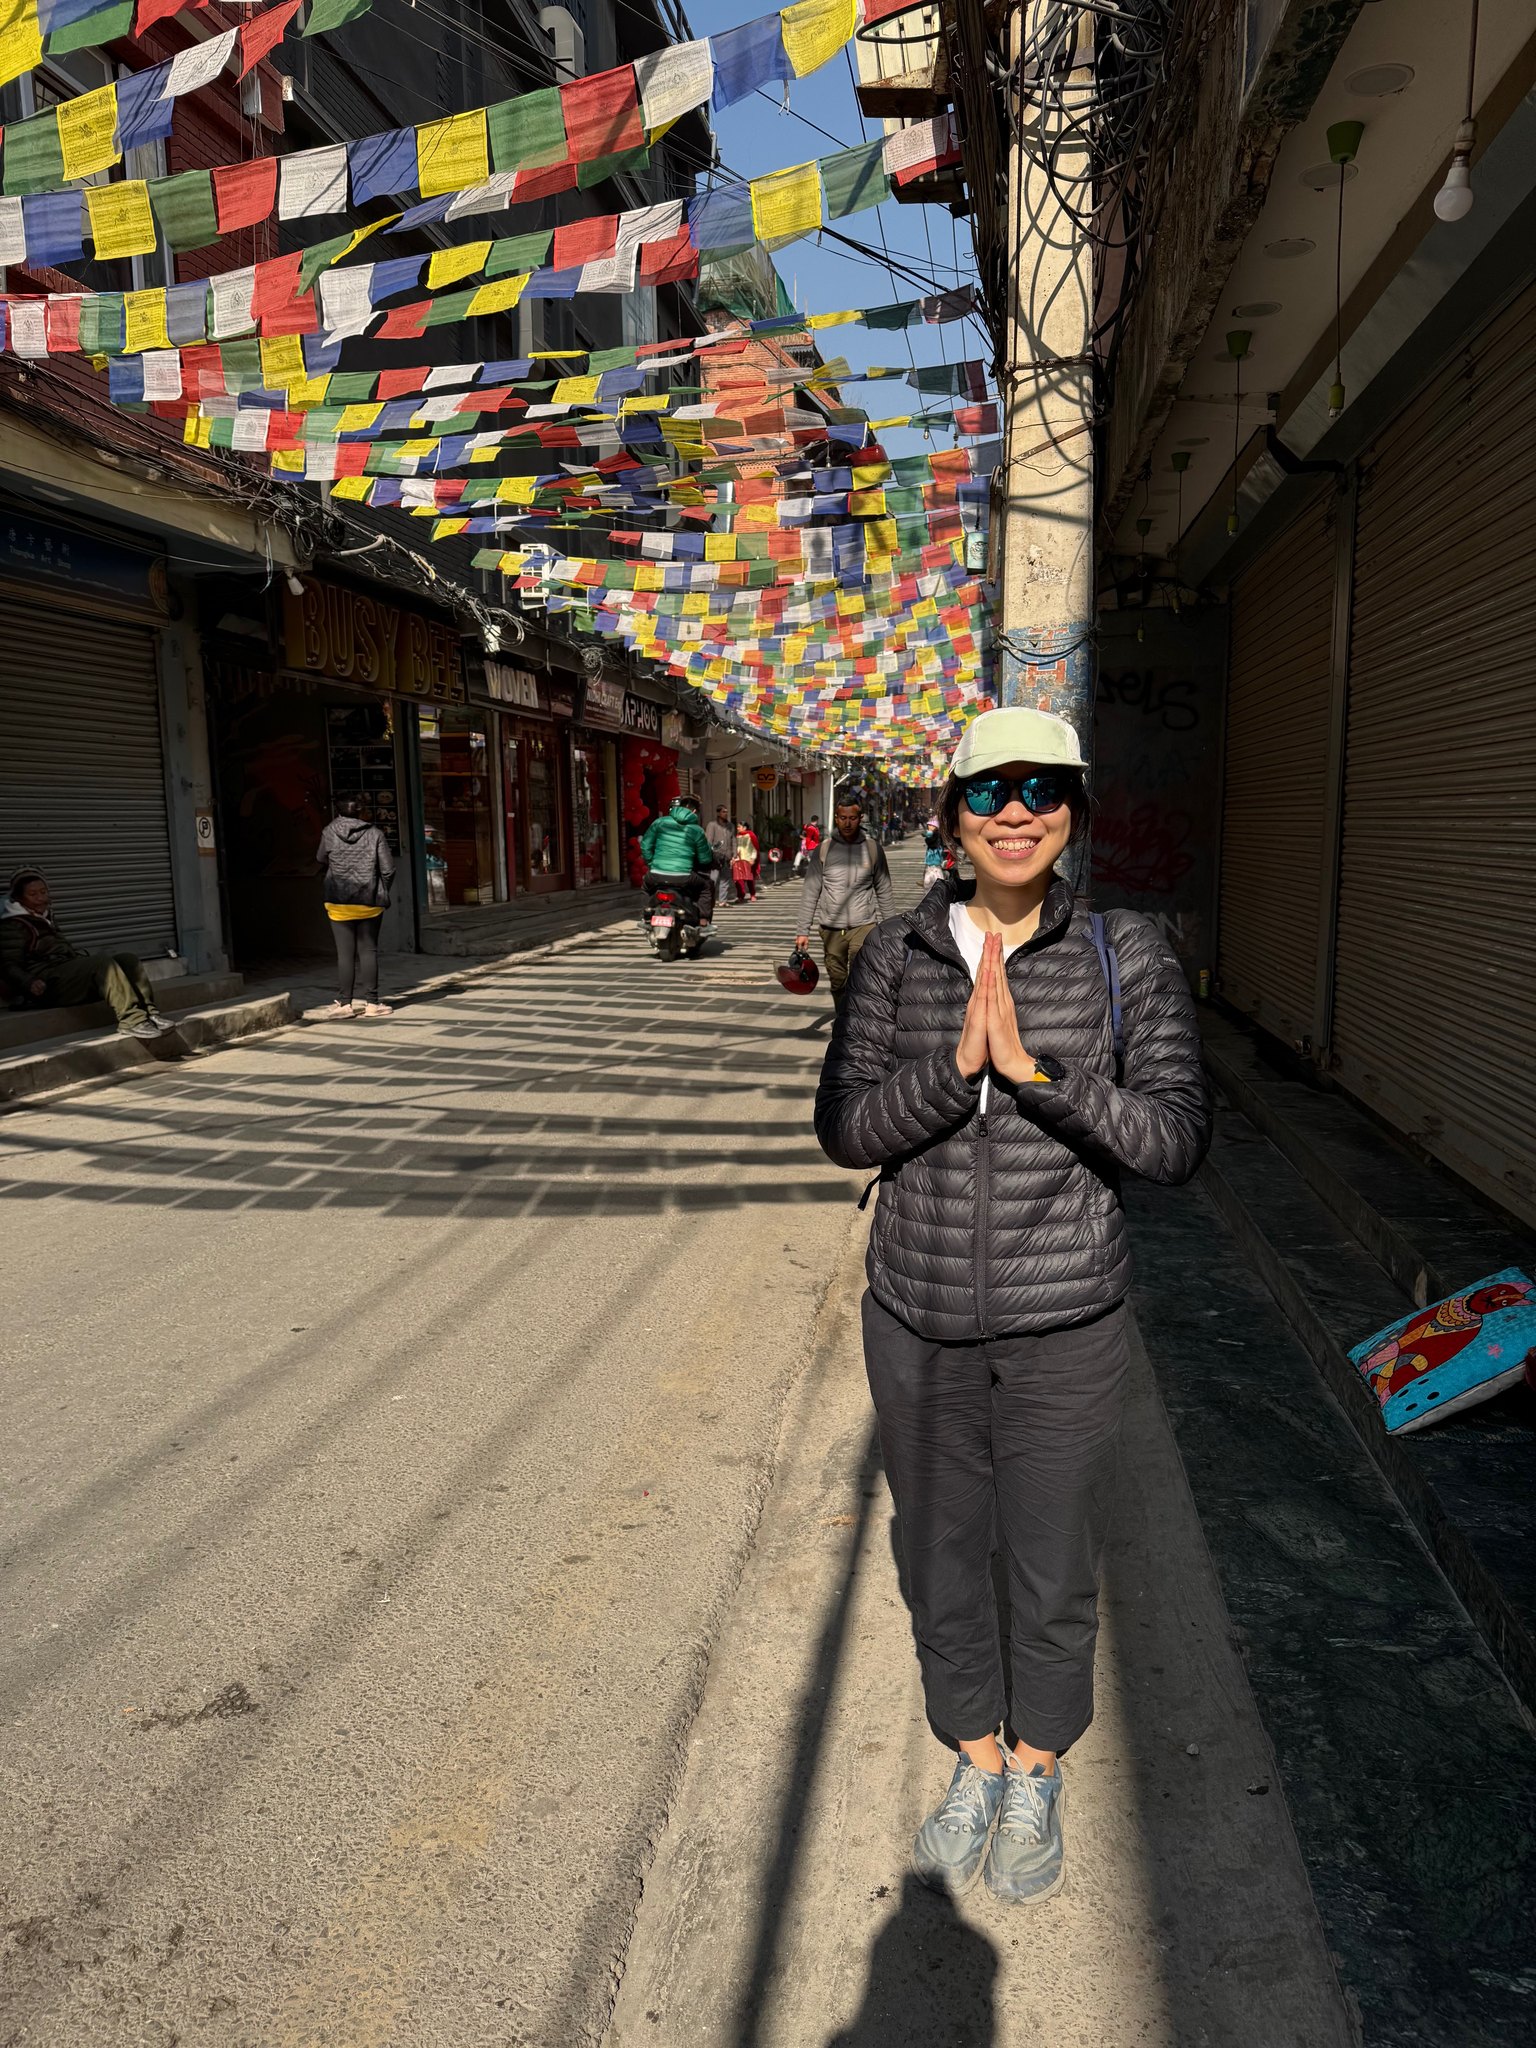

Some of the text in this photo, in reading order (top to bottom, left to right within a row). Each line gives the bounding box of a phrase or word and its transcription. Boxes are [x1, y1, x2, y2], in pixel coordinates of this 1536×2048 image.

[302, 575, 466, 703] BUSY BEE
[483, 660, 539, 709] WOVEN
